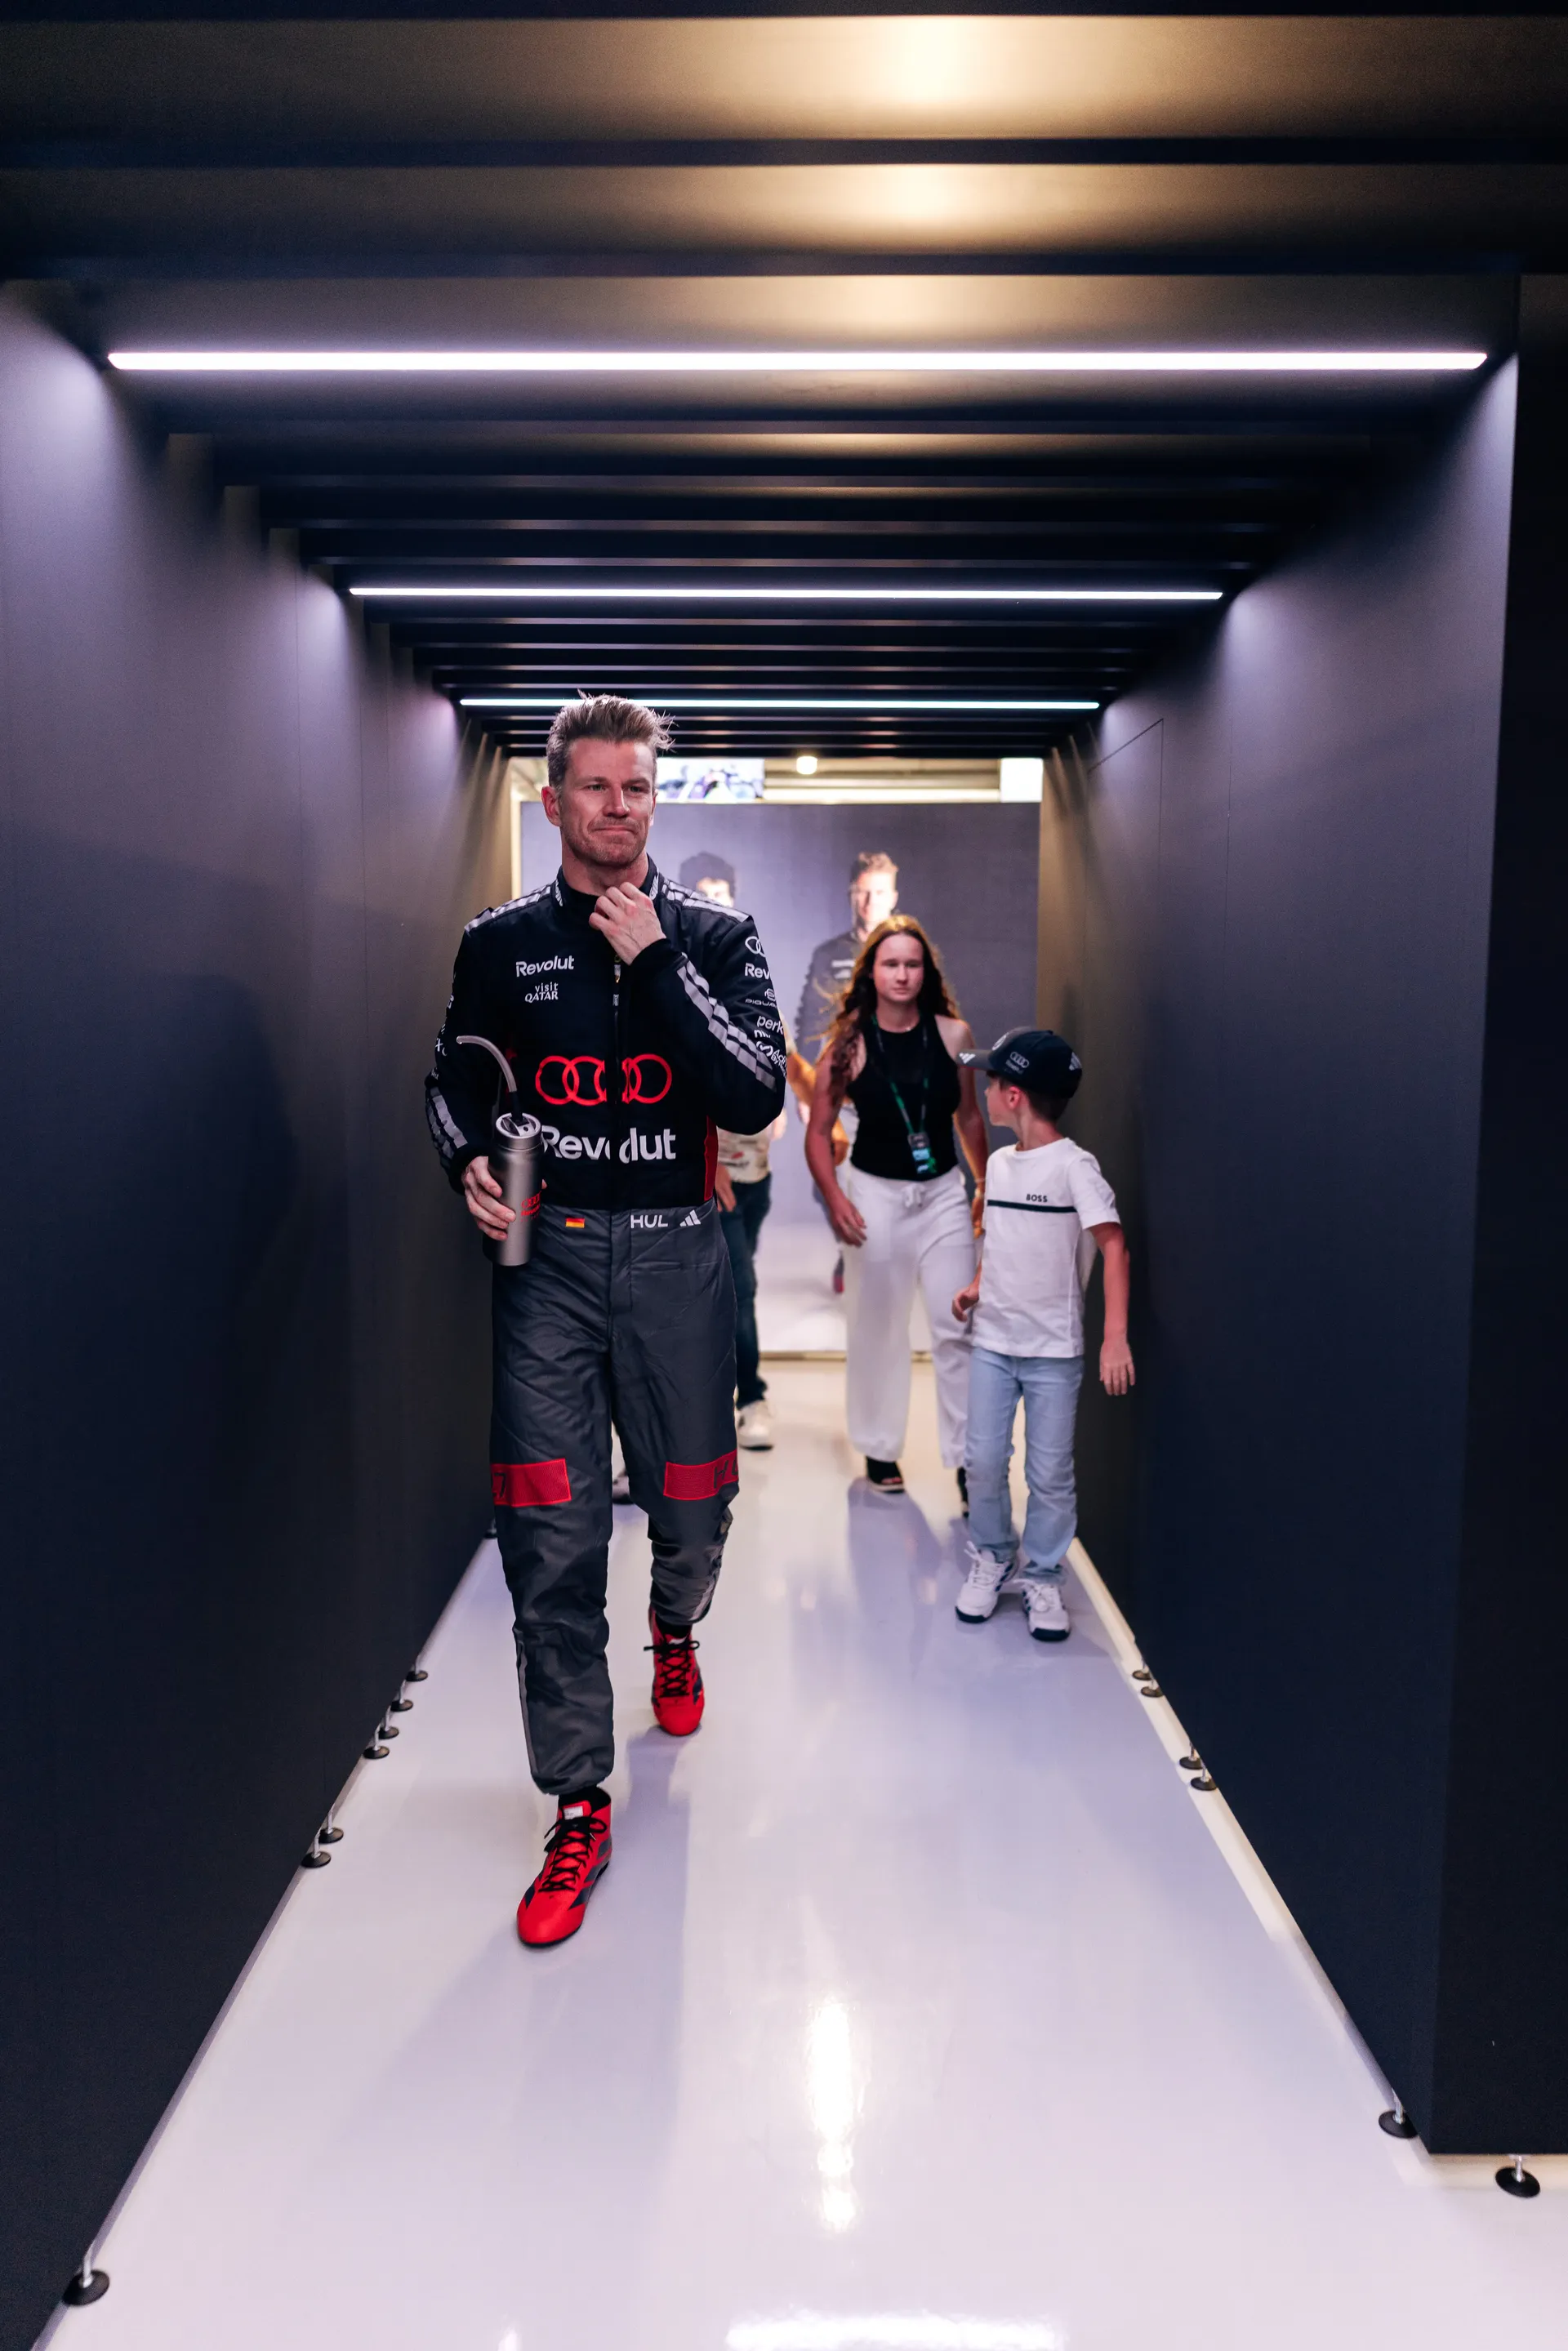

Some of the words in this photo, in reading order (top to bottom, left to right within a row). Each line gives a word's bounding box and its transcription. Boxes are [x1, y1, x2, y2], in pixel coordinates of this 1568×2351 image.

[515, 955, 575, 977] Revolut
[535, 982, 559, 993] visit
[524, 991, 559, 1004] QATAR
[1026, 1193, 1048, 1203] BOSS
[630, 1214, 668, 1228] HUL
[491, 1472, 506, 1498] 7
